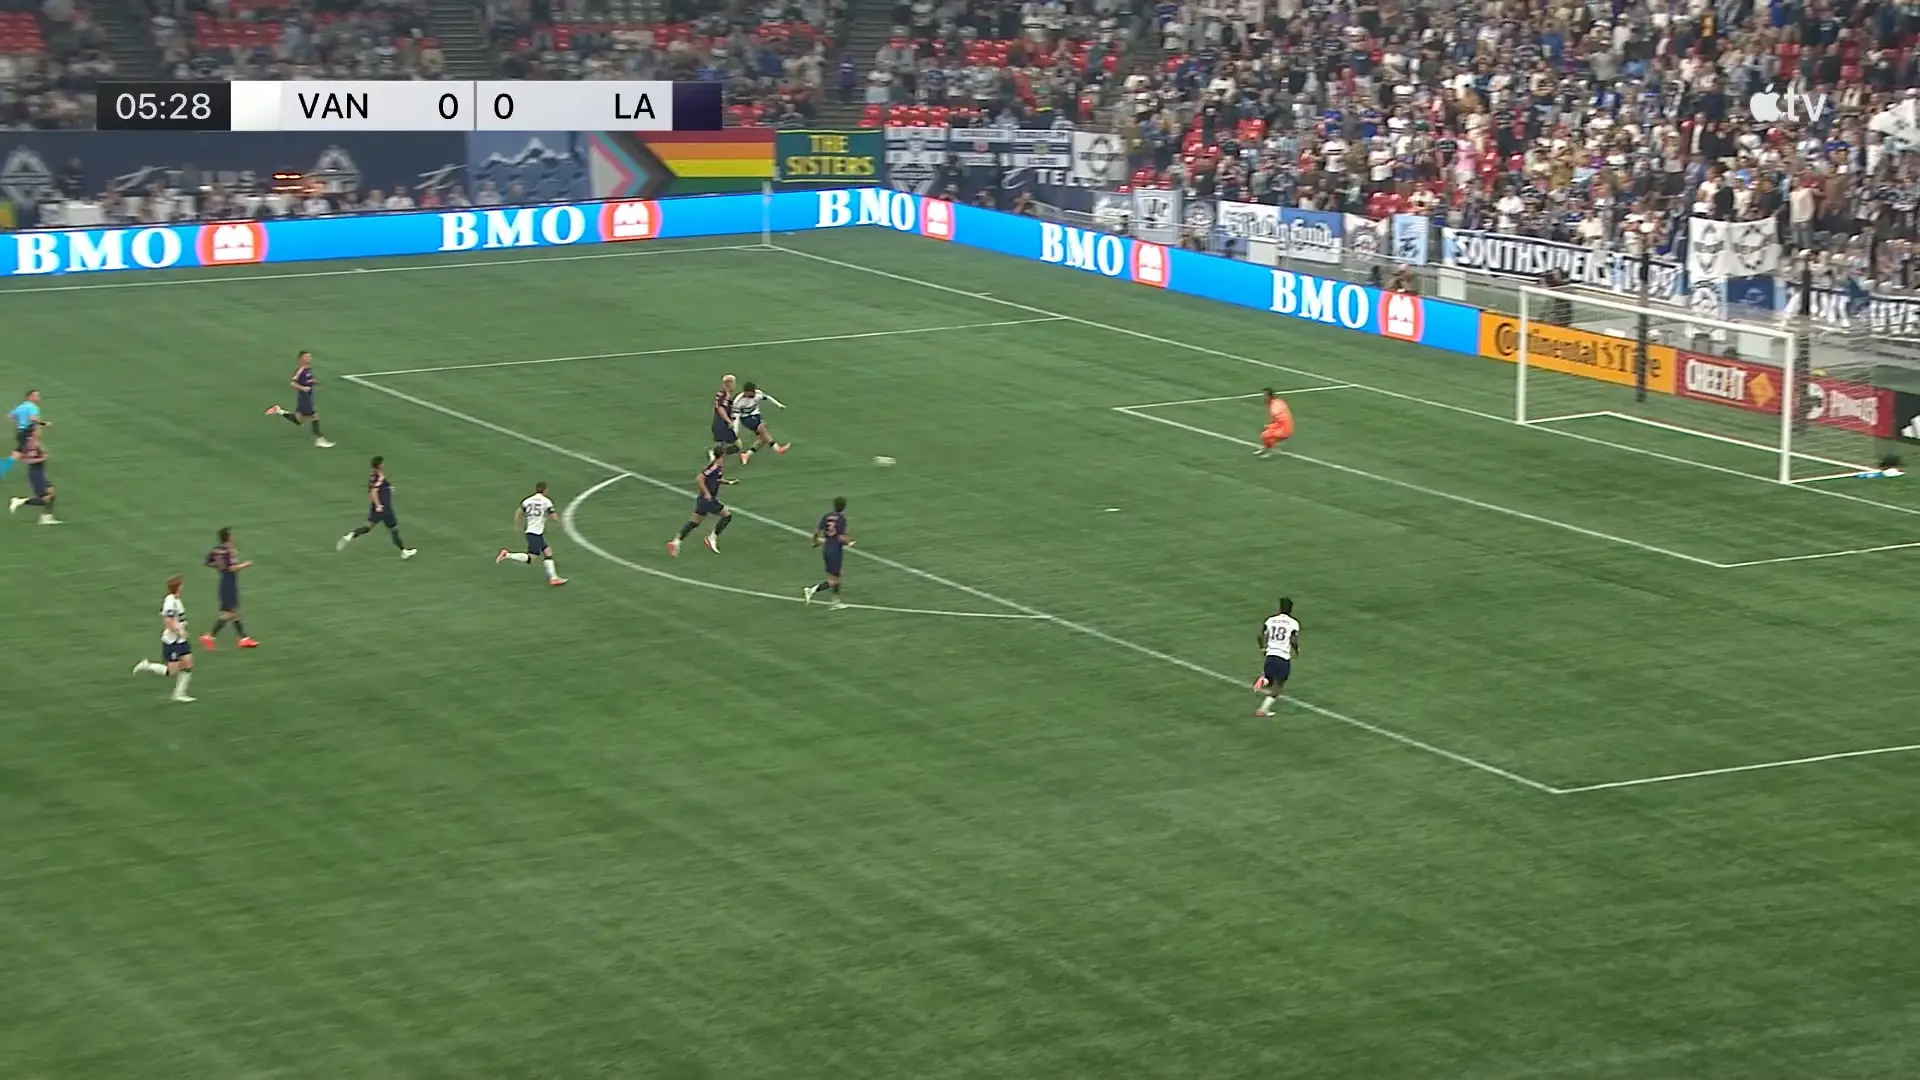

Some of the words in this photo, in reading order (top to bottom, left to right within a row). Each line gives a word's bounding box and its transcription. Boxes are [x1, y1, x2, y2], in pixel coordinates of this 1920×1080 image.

[808, 133, 850, 154] THE
[785, 155, 876, 176] SISTERS
[438, 205, 585, 252] BMO
[815, 187, 916, 232] BMO
[12, 226, 182, 275] BMO
[1039, 222, 1125, 277] BMO
[1270, 269, 1370, 329] BMO
[1614, 344, 1662, 378] Tie
[525, 503, 543, 517] 25
[1271, 625, 1288, 641] 18
